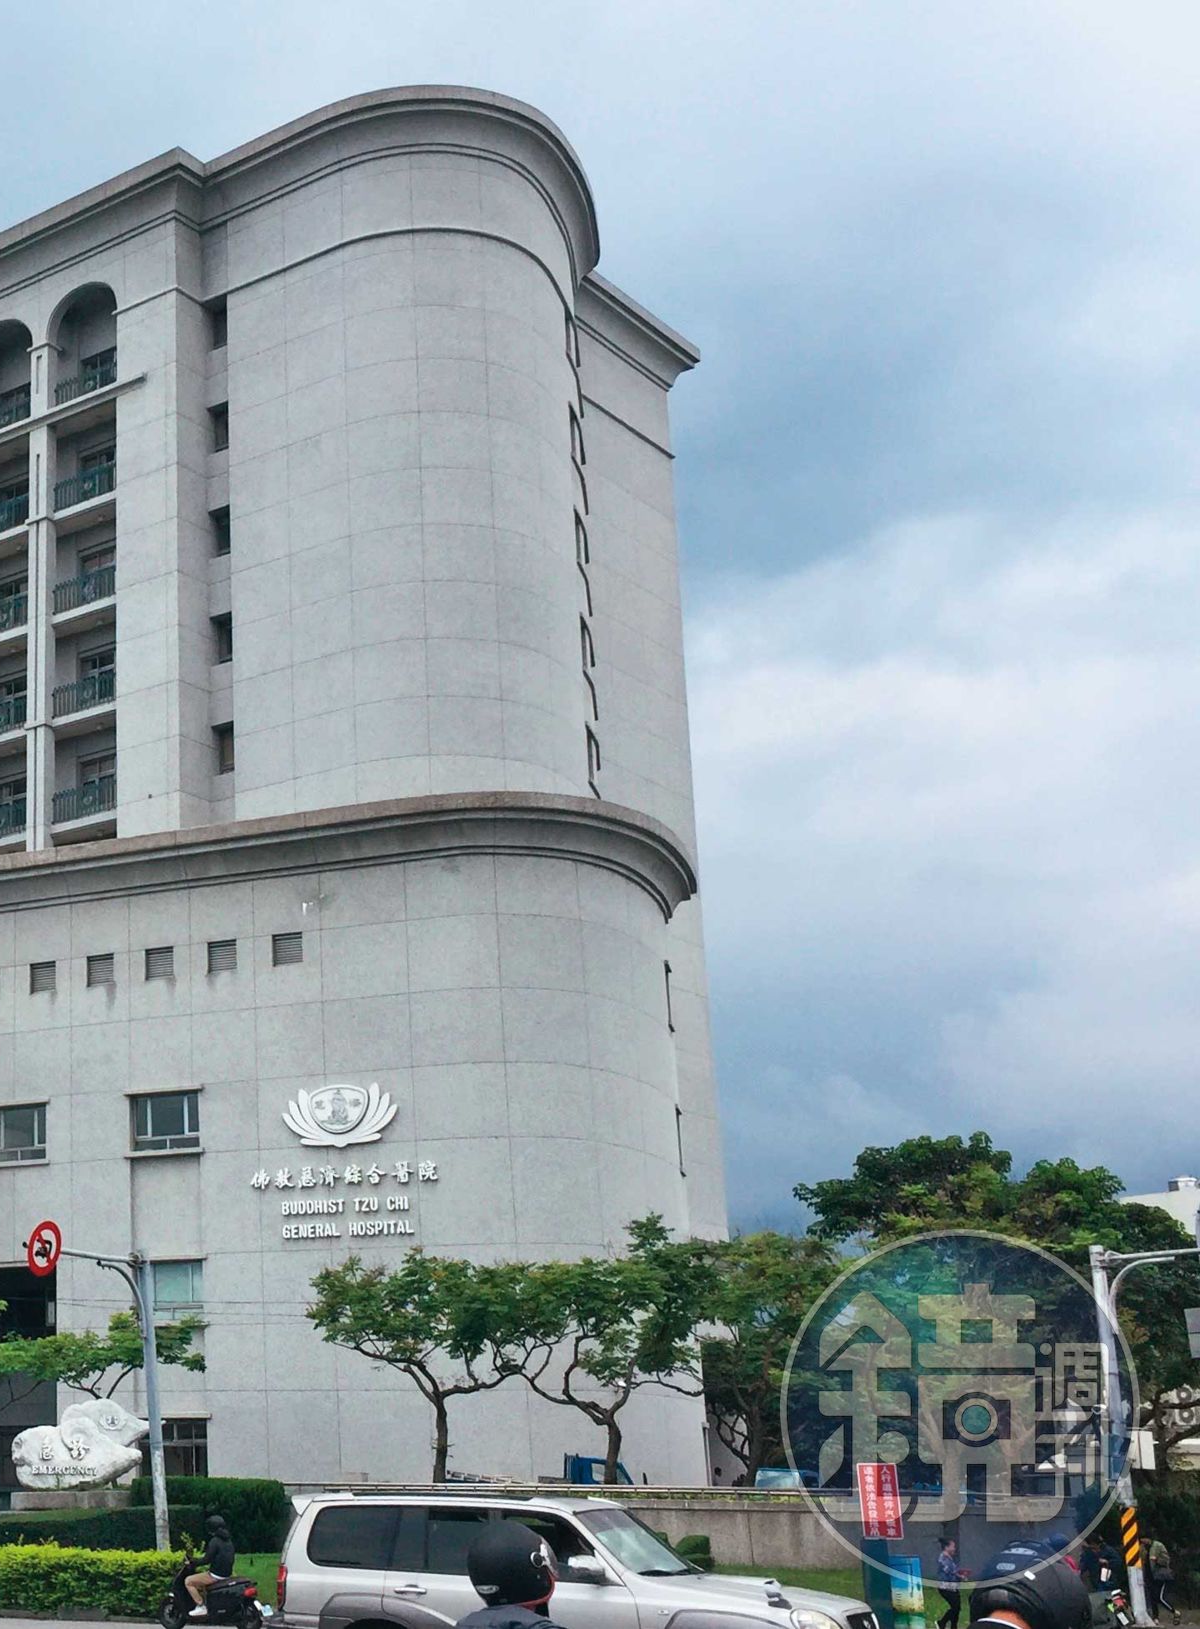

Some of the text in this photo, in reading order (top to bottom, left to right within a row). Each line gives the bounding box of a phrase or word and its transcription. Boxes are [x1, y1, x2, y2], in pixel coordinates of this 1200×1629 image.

[250, 1160, 439, 1190] 佛教慈濟綜合醫院
[281, 1196, 409, 1216] BUDDHIST TZU CHI
[282, 1220, 415, 1239] GENERAL HOSPITAL
[39, 1436, 90, 1461] 急診
[32, 1465, 98, 1477] EMERGENCY
